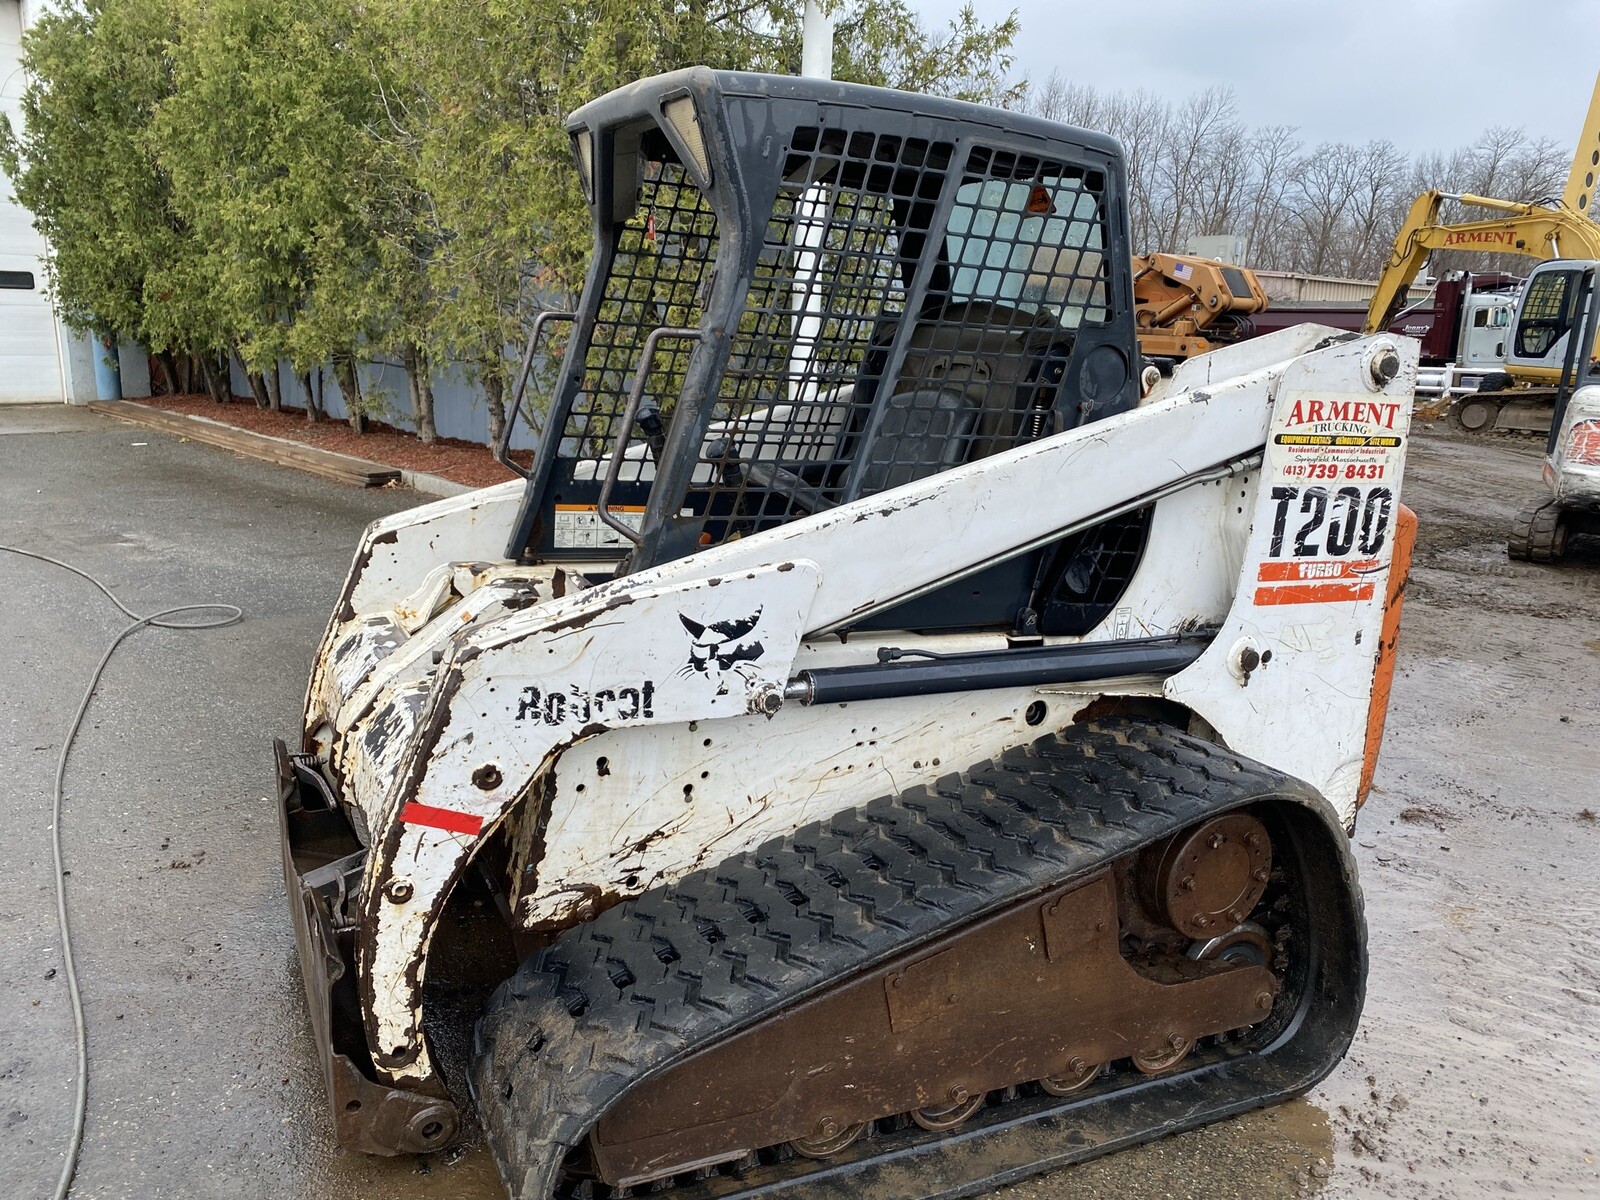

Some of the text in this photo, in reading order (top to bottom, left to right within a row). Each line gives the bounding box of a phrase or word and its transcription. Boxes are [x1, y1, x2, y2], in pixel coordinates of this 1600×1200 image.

[1443, 231, 1517, 246] ARMENT
[1285, 399, 1400, 430] ARMENT
[1312, 422, 1368, 435] TRUCKING
[1280, 435, 1309, 444] EQUIPMENT
[1330, 455, 1377, 463] Massachusetts
[1282, 463, 1385, 479] (413) 739-8431
[1269, 486, 1393, 558] T200
[1298, 563, 1342, 579] TURBO
